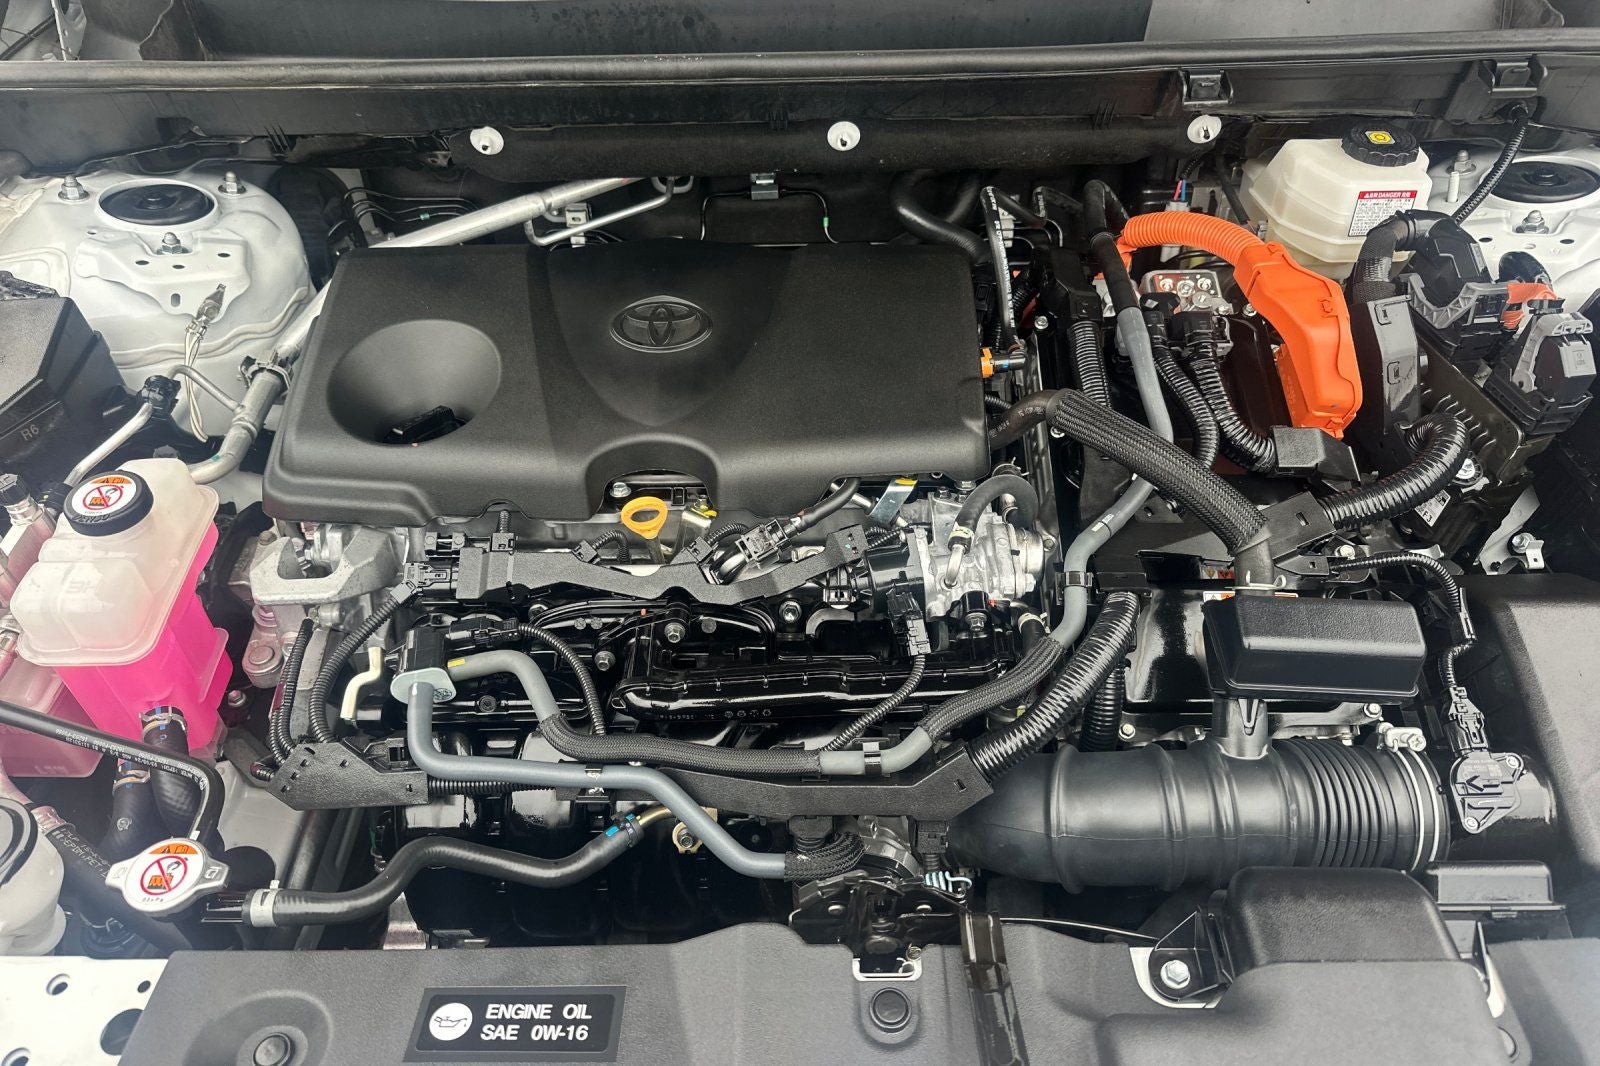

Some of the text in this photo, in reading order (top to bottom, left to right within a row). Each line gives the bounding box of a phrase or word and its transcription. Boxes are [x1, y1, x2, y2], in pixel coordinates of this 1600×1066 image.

[1377, 191, 1401, 199] DANGER
[20, 424, 39, 441] R6
[485, 1003, 592, 1020] ENGINE OIL
[480, 1024, 588, 1041] SAE 0W-16
